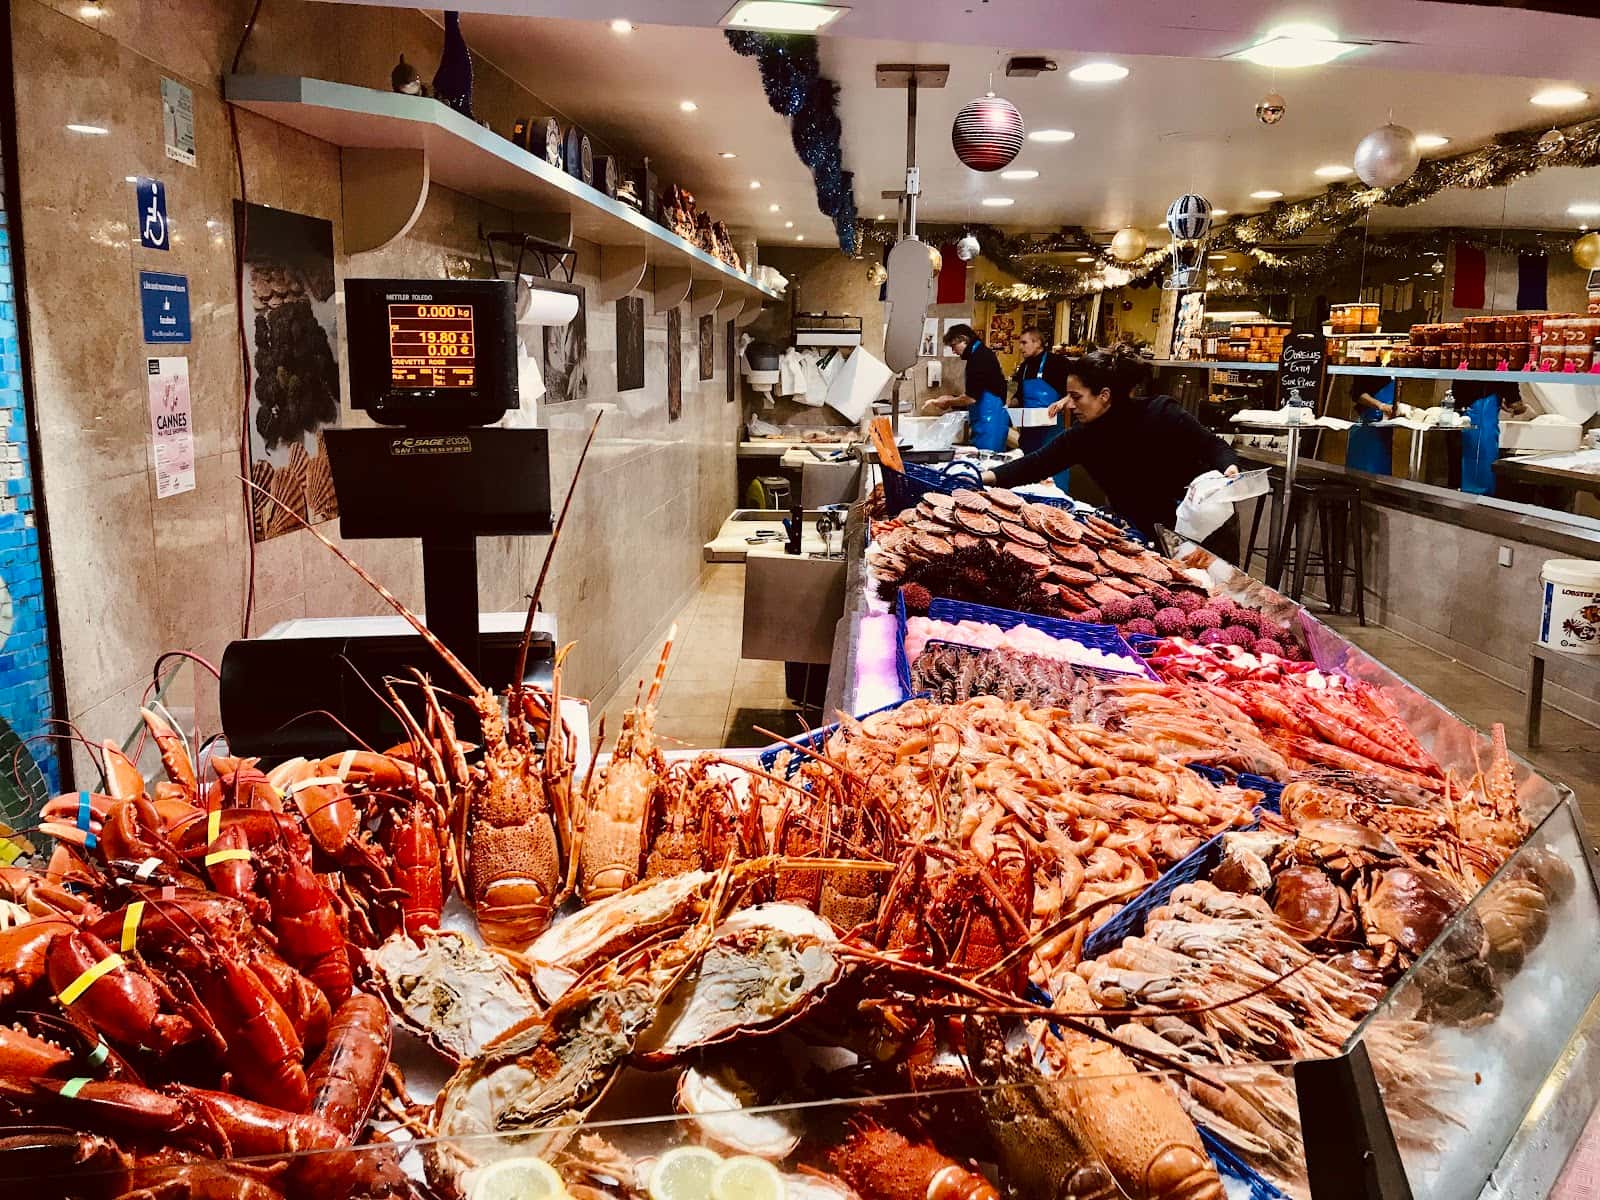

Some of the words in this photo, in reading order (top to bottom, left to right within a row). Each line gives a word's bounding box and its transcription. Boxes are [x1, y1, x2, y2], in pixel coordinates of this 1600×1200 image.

[386, 293, 410, 301] METTLER
[417, 306, 456, 318] 0.000
[457, 307, 470, 318] kg
[418, 331, 457, 344] 19.80
[427, 345, 458, 356] 0.00
[156, 412, 187, 430] CANNES
[1562, 588, 1594, 598] LOBSTER
